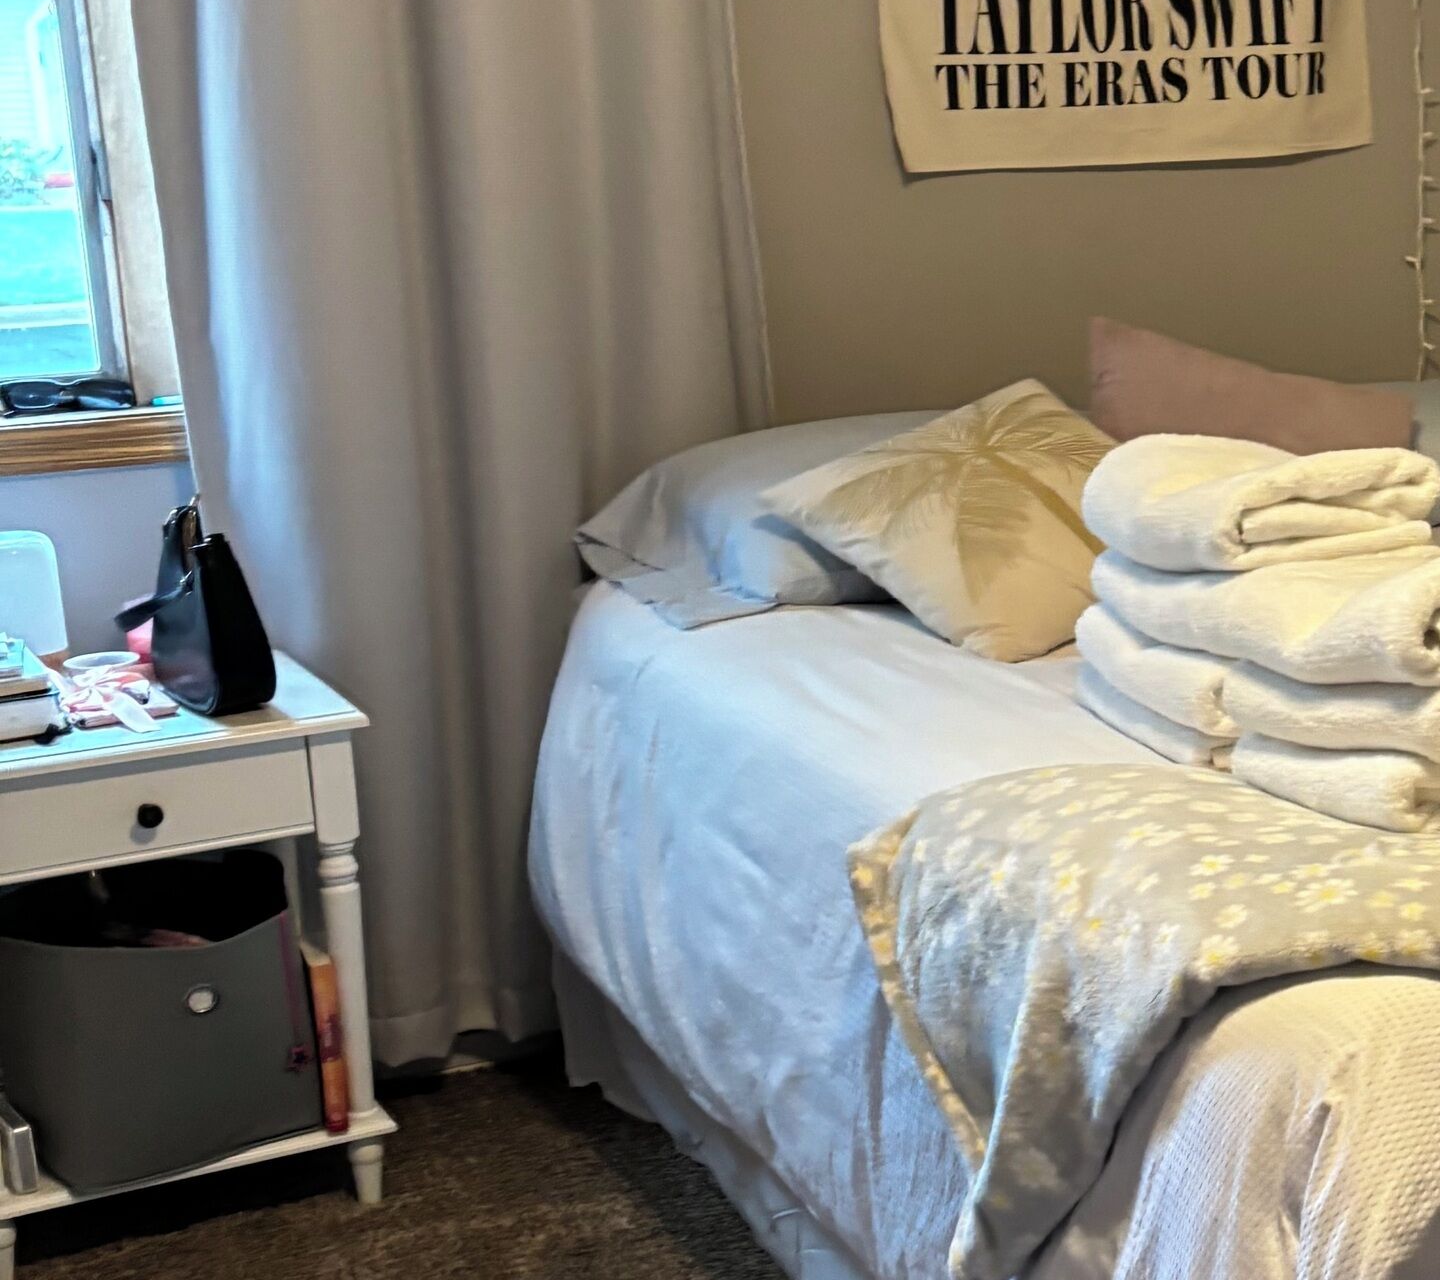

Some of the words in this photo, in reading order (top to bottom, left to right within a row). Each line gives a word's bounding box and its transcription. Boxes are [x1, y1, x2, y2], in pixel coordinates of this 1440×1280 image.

[935, 63, 1048, 110] THE
[1061, 56, 1189, 108] ERAS
[1201, 51, 1326, 101] TOUR
